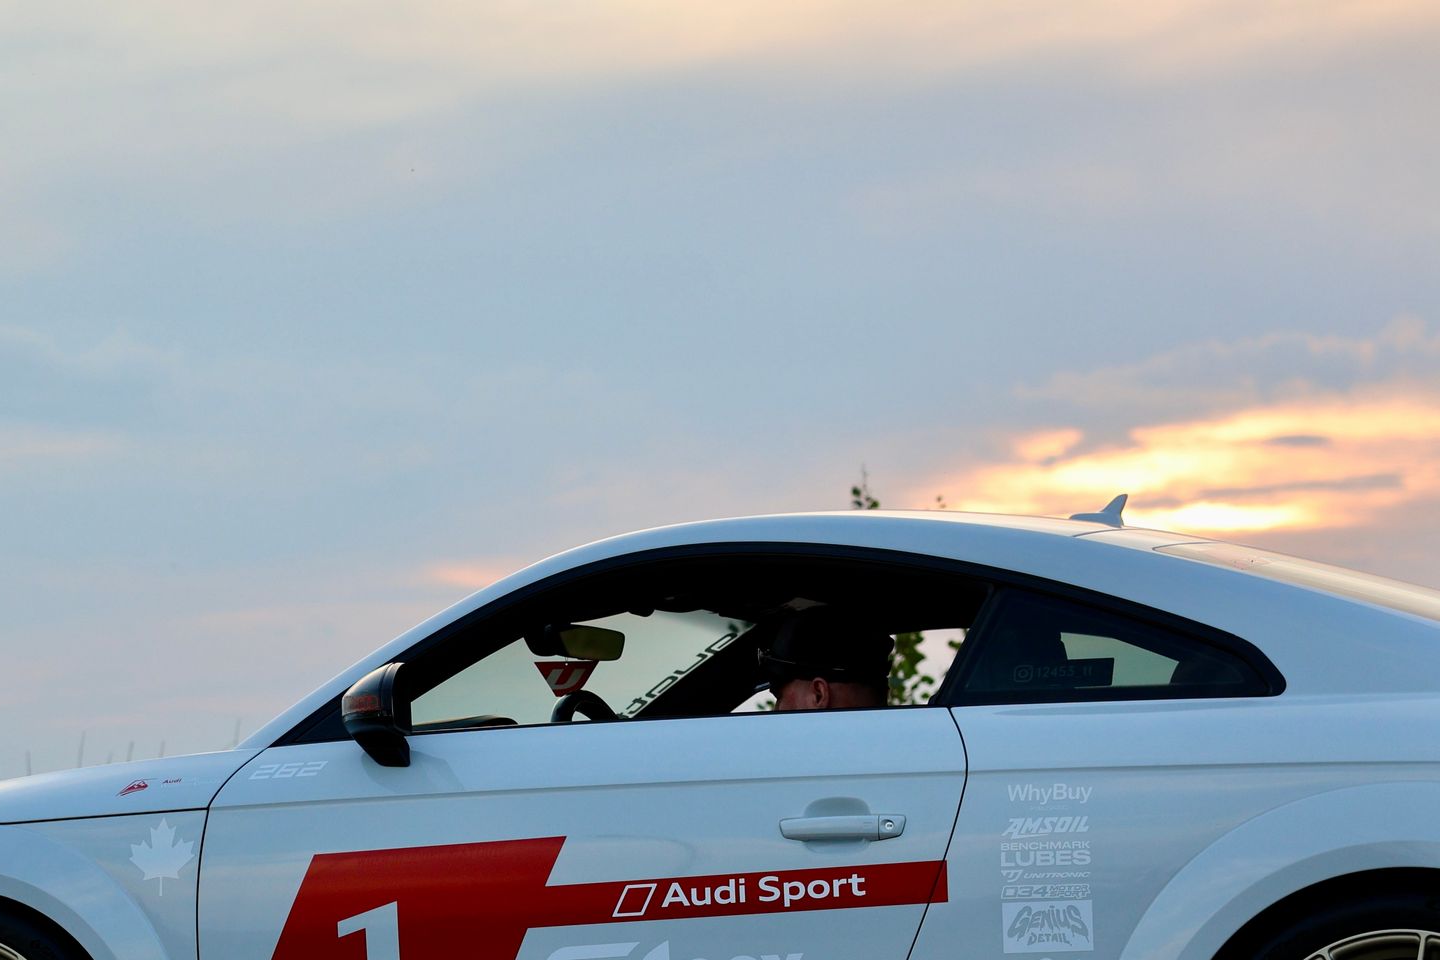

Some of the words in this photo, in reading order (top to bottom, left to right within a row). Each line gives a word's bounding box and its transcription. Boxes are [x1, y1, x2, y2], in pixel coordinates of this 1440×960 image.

[248, 760, 328, 780] 262
[1007, 783, 1093, 805] WhyBuy
[1001, 815, 1091, 840] AMSOIL
[1000, 840, 1091, 851] BENCHMARK
[1000, 850, 1092, 867] LUBES
[661, 878, 746, 908] Audi
[759, 873, 866, 907] Sport
[1027, 932, 1073, 946] DETAIL
